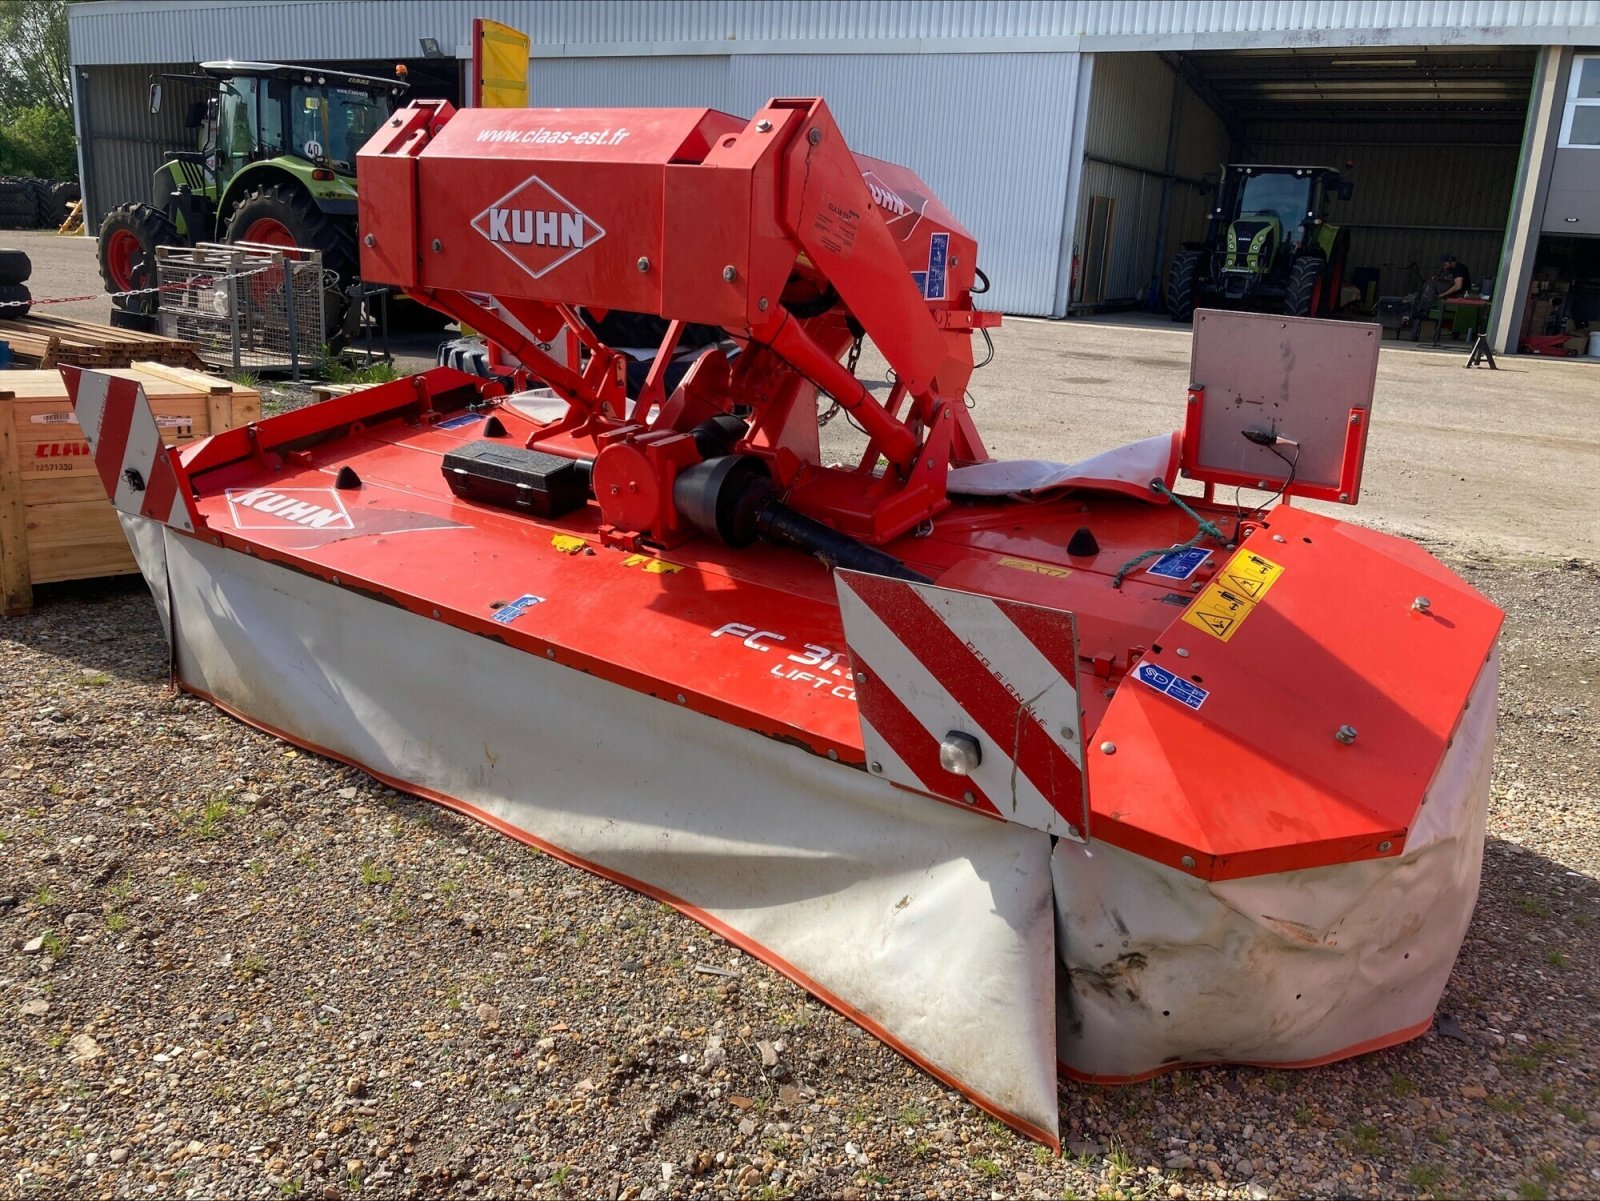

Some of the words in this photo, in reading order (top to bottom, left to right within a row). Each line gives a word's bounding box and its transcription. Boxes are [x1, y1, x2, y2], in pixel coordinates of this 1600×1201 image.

[307, 143, 319, 155] 40
[475, 127, 631, 146] www.claas-est.fr
[868, 182, 905, 217] UHN
[489, 207, 584, 250] KUHN
[228, 488, 347, 529] KUHN
[710, 622, 787, 653] FC
[770, 663, 833, 689] LIFT
